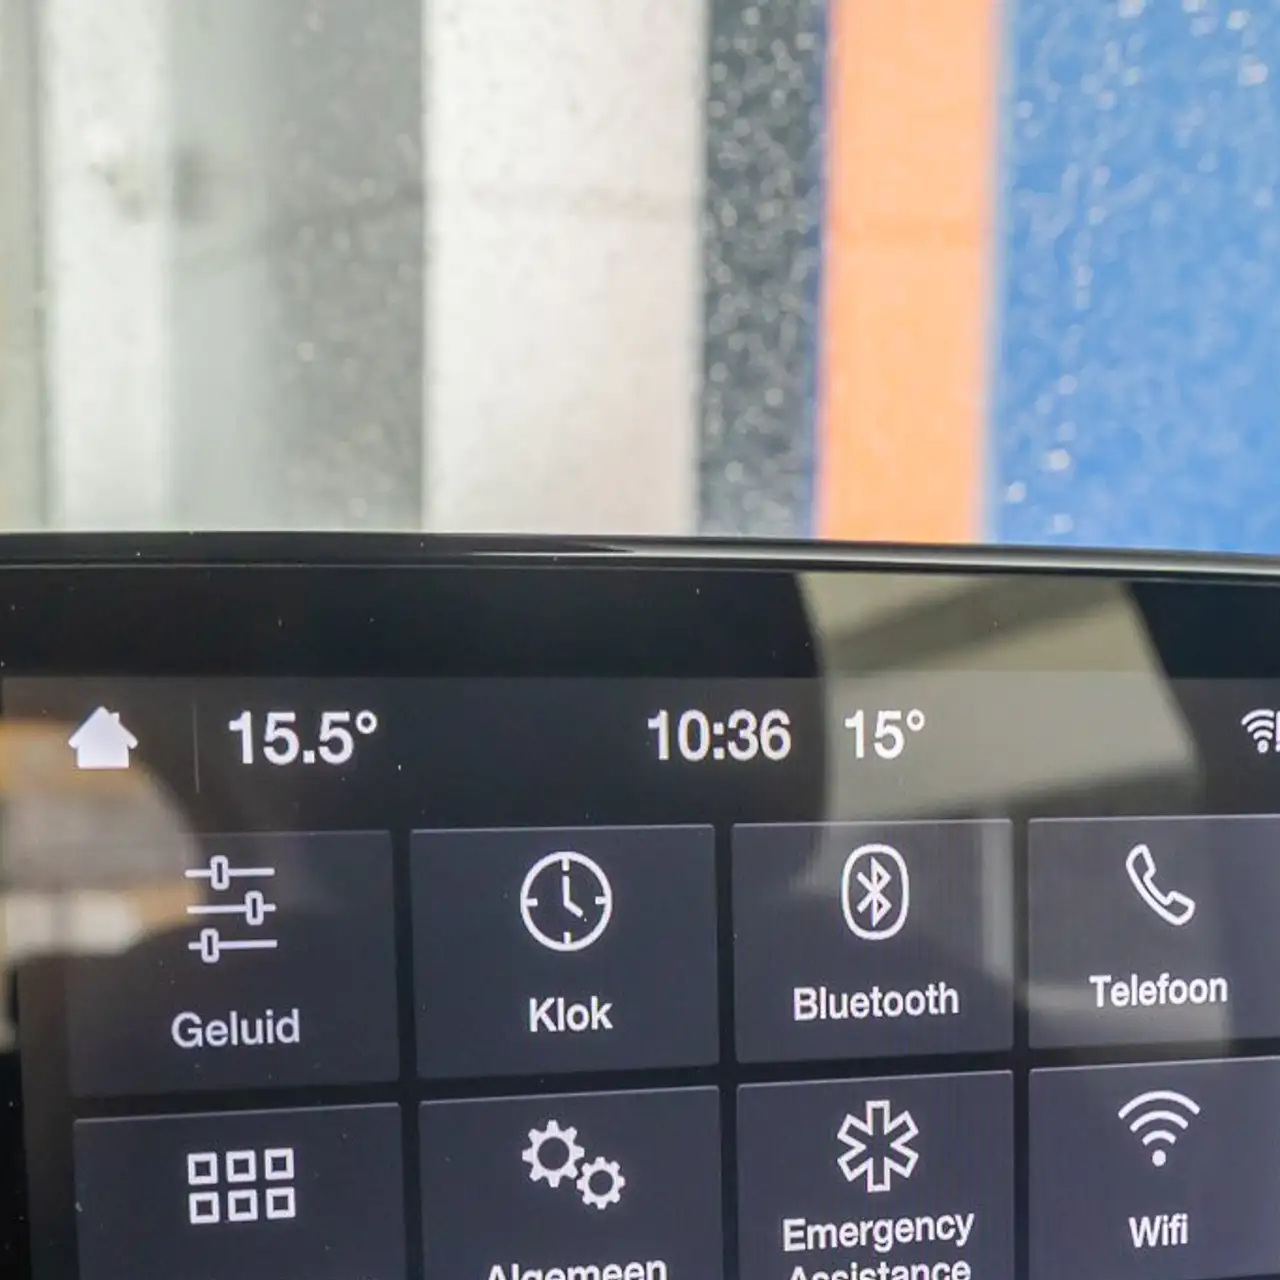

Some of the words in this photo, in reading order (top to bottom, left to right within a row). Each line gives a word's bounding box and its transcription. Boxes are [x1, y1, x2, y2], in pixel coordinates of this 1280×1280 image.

[647, 709, 792, 761] 10:36
[793, 982, 959, 1021] Bluetooth
[1089, 973, 1228, 1008] Telefoon
[171, 1009, 300, 1048] Geluid
[528, 997, 613, 1033] Klok
[782, 1213, 974, 1252] Emergency
[1129, 1213, 1189, 1248] Wifi
